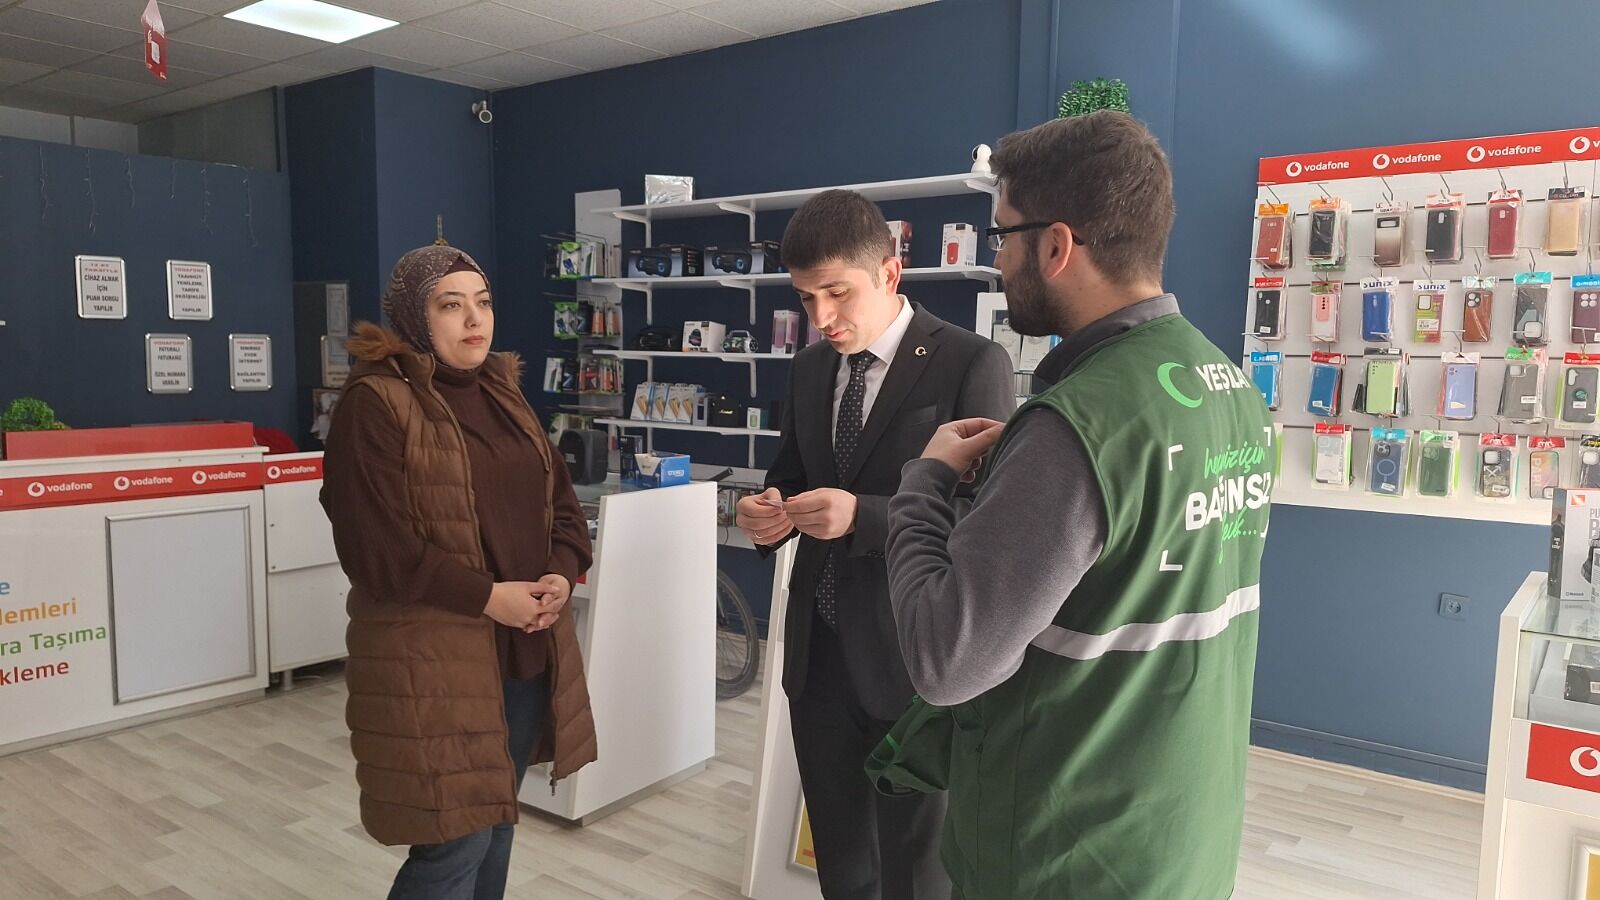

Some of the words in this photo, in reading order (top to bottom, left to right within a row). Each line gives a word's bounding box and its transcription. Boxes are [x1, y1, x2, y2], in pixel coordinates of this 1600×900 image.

[1488, 144, 1541, 156] vodafone
[1392, 151, 1441, 164] vodafone
[1304, 160, 1350, 172] vodafone
[1195, 363, 1251, 395] YEŞİLA
[208, 470, 247, 481] vodafone
[282, 465, 317, 475] vodafone
[47, 481, 93, 492] vodafone
[131, 475, 173, 486] vodafone
[0, 640, 22, 656] ra
[29, 626, 107, 651] Taşıma
[0, 661, 69, 686] kleme
